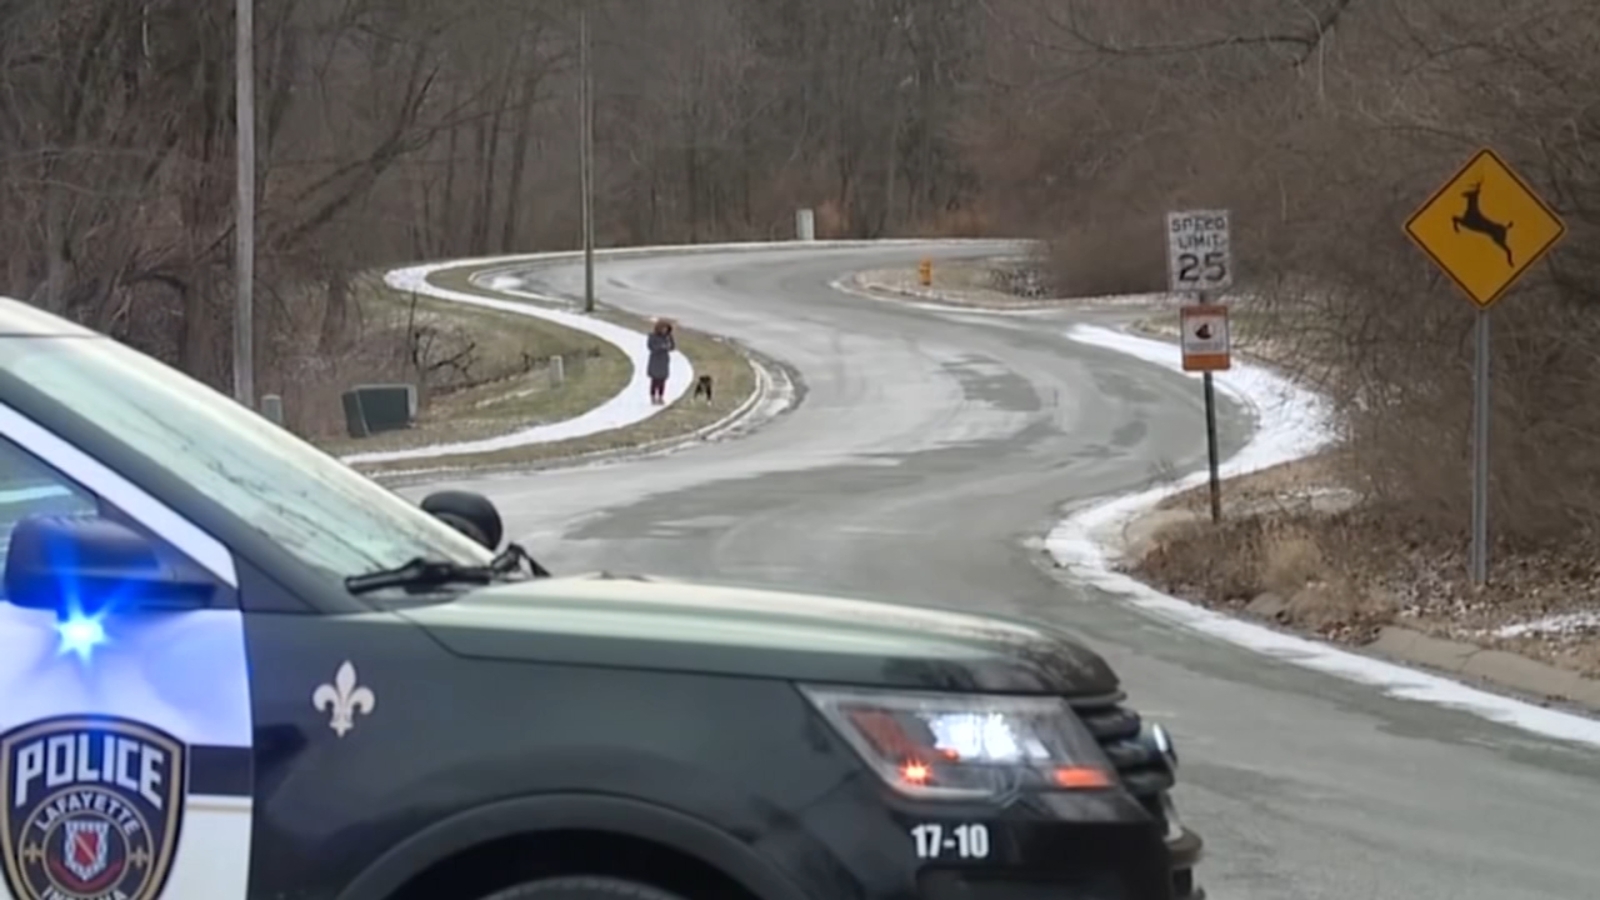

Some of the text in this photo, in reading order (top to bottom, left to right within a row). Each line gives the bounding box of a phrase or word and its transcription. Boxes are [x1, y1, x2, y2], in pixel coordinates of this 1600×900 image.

[1171, 215, 1226, 232] SPEED
[1178, 234, 1223, 250] LIMIT
[1178, 253, 1227, 283] 25
[16, 733, 163, 809] POLICE
[35, 791, 140, 836] LAFAYETTE
[911, 823, 989, 858] 17-10
